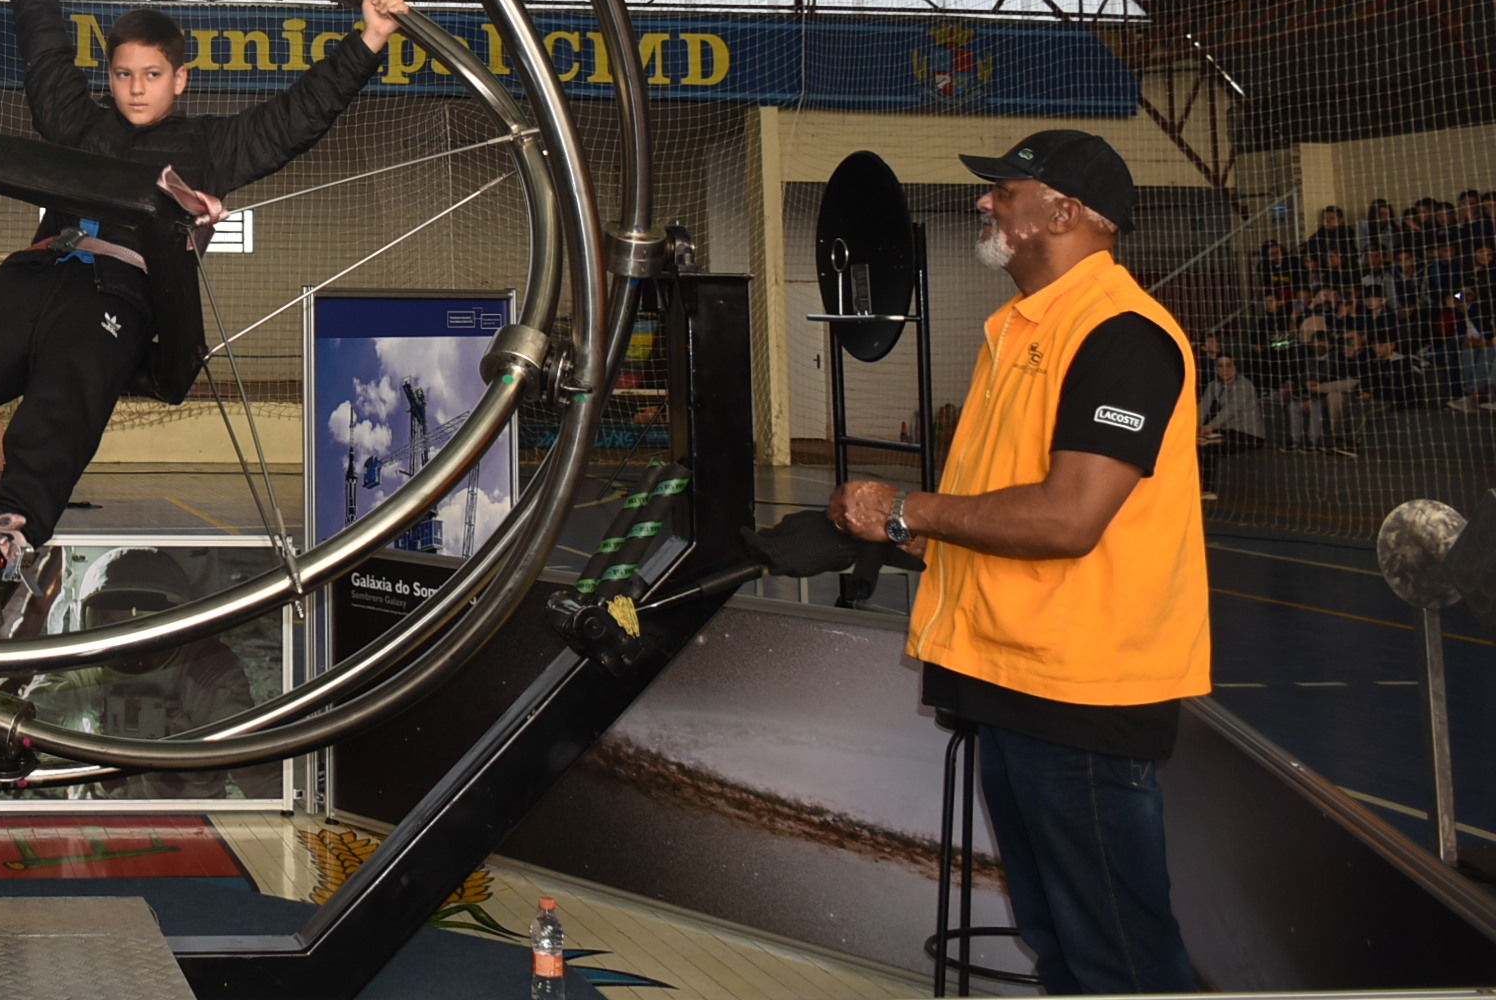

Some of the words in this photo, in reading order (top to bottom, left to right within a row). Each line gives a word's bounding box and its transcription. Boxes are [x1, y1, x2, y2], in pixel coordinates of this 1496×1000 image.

[69, 14, 511, 84] Municpl
[542, 31, 730, 86] CMD
[1099, 410, 1140, 427] LACOSTE
[351, 572, 393, 593] Galáxia
[395, 579, 410, 595] do
[351, 589, 385, 604] Sombrero
[385, 595, 407, 609] Galaxy
